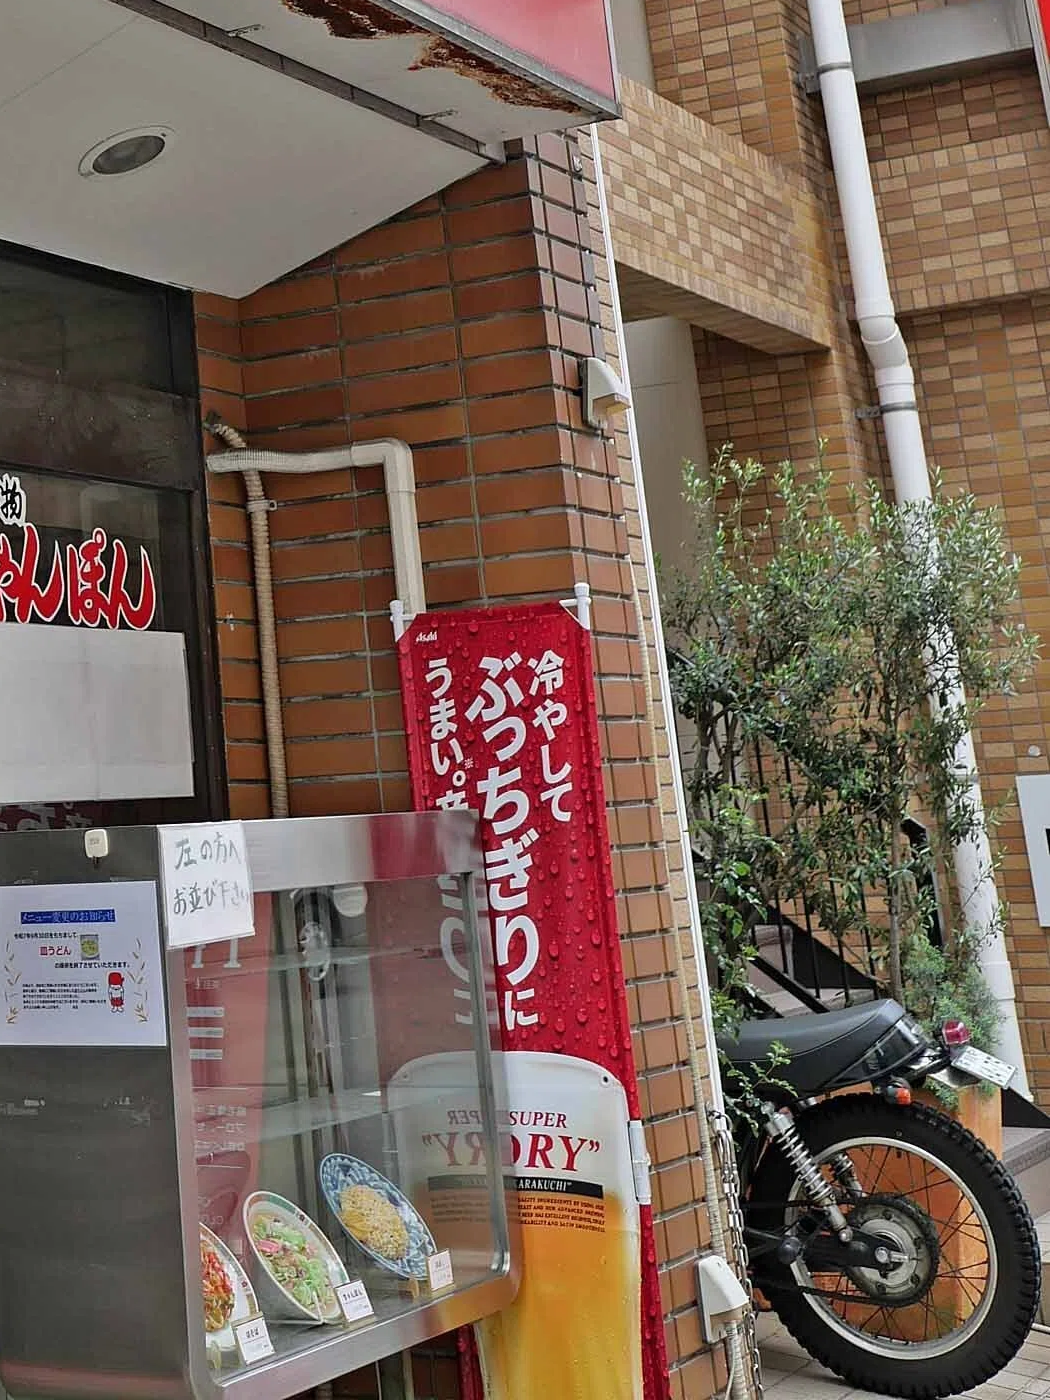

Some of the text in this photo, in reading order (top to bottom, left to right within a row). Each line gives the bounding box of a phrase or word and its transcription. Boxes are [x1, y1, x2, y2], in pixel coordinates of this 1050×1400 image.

[416, 631, 438, 642] Asahi
[527, 650, 572, 822] 冷やして
[465, 650, 540, 1031] ぶっちぎりに
[509, 1111, 567, 1129] SUPER
